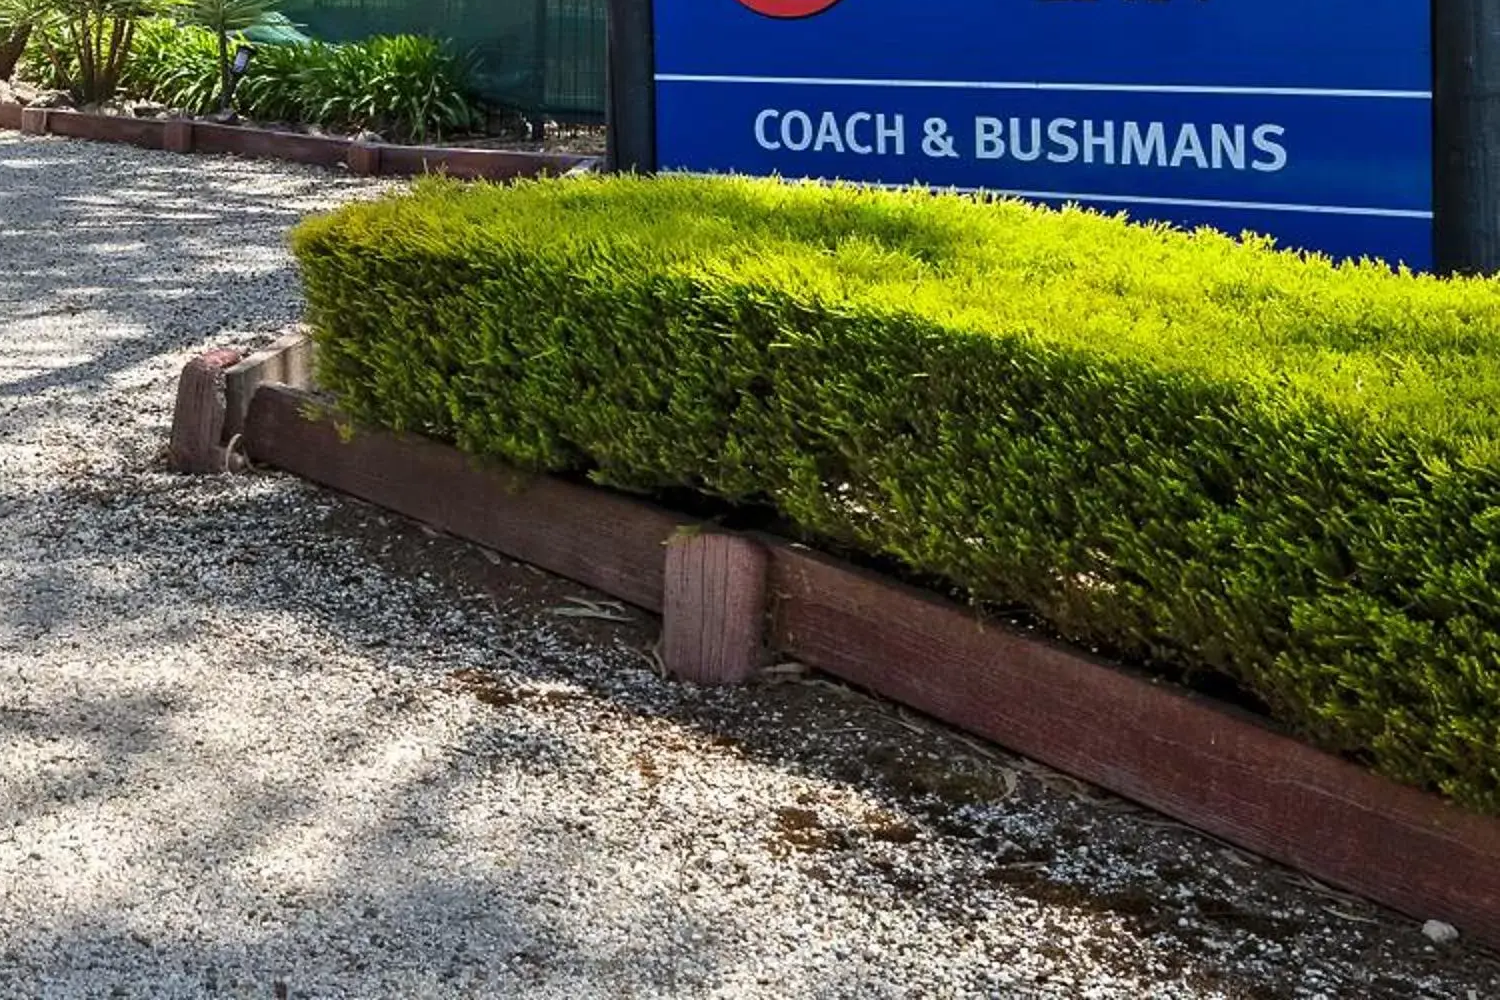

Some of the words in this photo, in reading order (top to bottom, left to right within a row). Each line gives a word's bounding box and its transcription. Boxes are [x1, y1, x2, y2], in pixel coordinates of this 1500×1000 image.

[754, 109, 905, 155] COACH
[921, 116, 959, 158] &
[975, 116, 1288, 172] BUSHMANS
